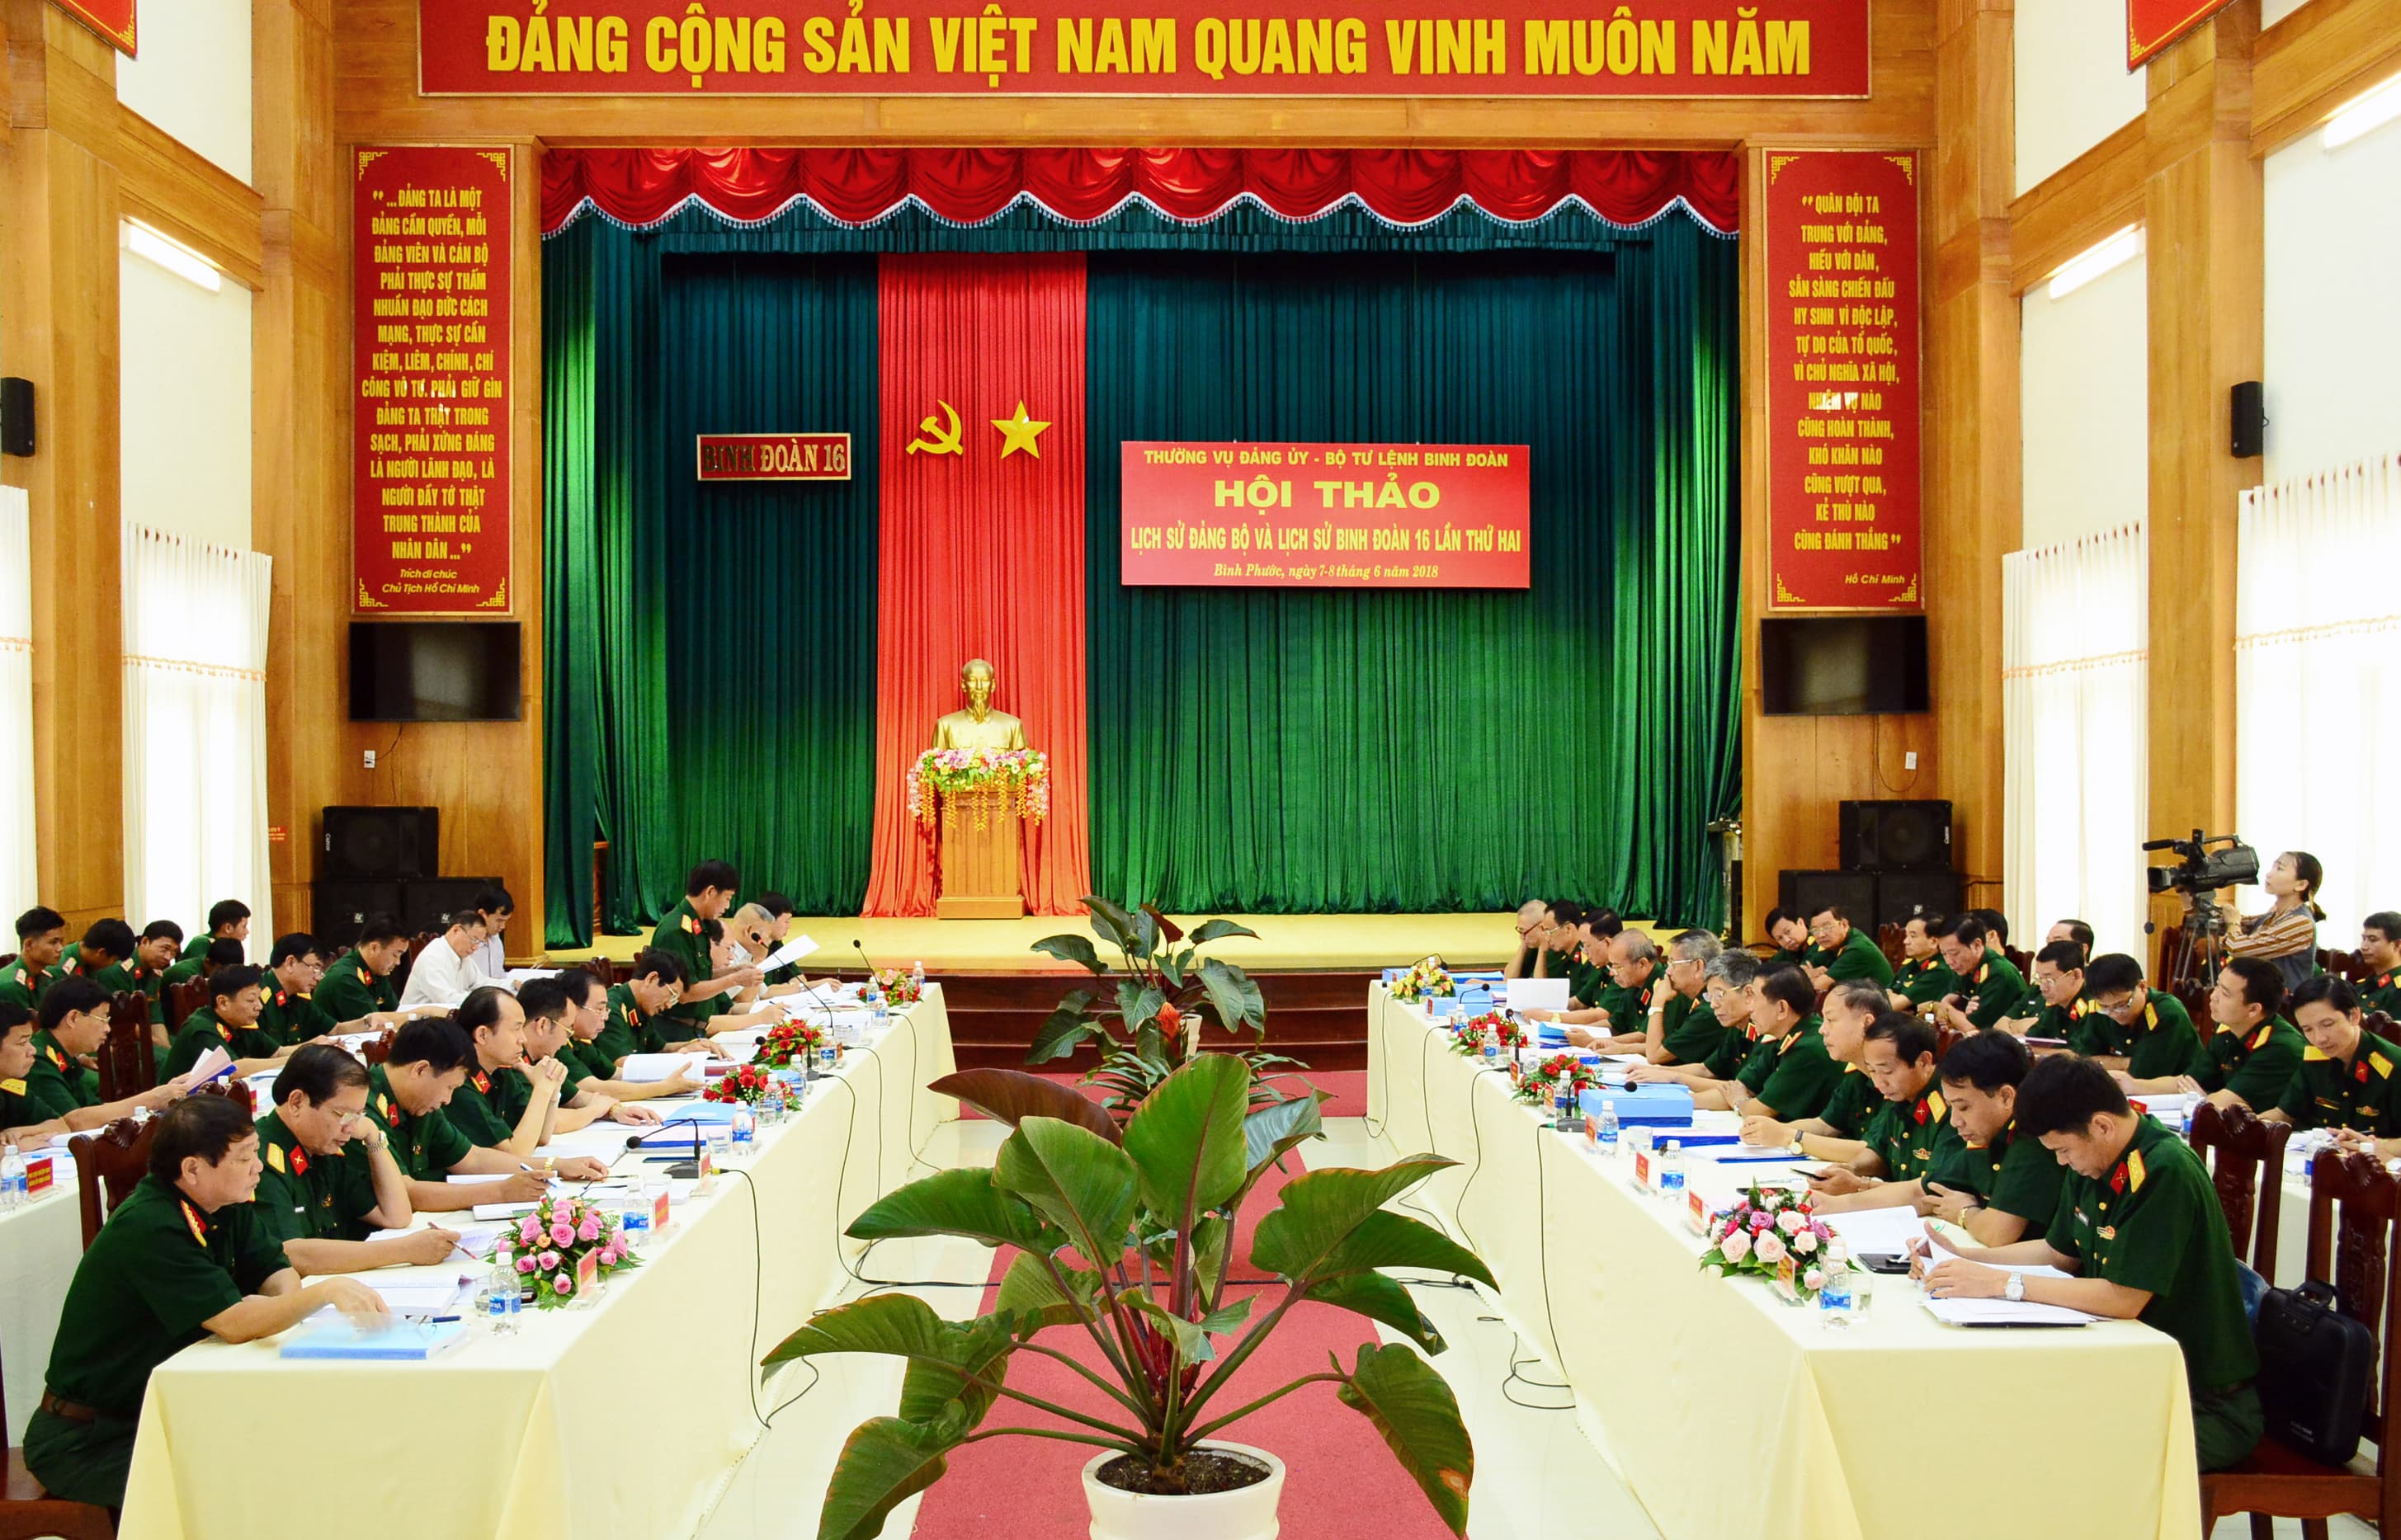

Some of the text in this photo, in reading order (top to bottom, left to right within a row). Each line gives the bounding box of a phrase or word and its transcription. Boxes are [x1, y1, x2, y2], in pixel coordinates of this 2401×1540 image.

[486, 0, 1809, 87] ĐẢNG CỘNG SẢN VIỆT NAM QUANG VINH MUÔN NĂM
[428, 186, 482, 211] TA LÀ MỘT
[1846, 192, 1879, 216] ĐỘI TA
[372, 211, 486, 235] ĐẢNG MỖI
[1801, 219, 1887, 244] TRUNG VỚI ĐẢNG,
[375, 239, 488, 266] ĐẢNG VIÊN VÀ CÁN BỘ
[1809, 248, 1879, 271] HIẾU VỚI DÂN,
[381, 266, 486, 293] PHẢI THỰC SỰ THẤM
[1812, 276, 1839, 298] SÀNG
[1842, 276, 1870, 298] CHIẾN
[1875, 277, 1894, 298] ĐẤU
[413, 299, 433, 319] ĐẠO
[436, 295, 458, 316] ĐỨC
[460, 295, 488, 317] CÁCH
[1795, 304, 1897, 328] HY SINH VÌ ĐỘC LẬP,
[378, 320, 486, 346] MẠNG, THỰC SỰ CẦN
[1796, 334, 1810, 357] TỰ
[1813, 337, 1826, 355] DO
[1828, 330, 1849, 354] CỦA
[1866, 332, 1897, 356] QUỐC,
[373, 349, 403, 373] KIỆM,
[405, 349, 434, 373] LIÊM,
[436, 350, 473, 373] CHÍNH,
[1794, 357, 1900, 384] VÌ CHỦ NGHĨA XÃ HỘI,
[362, 374, 502, 398] CÔNG VÔ TƯ. PHẢI GIỮ GÌN
[1844, 392, 1858, 413] VỤ
[1861, 389, 1881, 410] NÀO
[376, 401, 488, 427] ĐẢNG TA THẬT TRONG
[1798, 416, 1894, 439] CŨNG HOÀN THÀNH,
[370, 427, 494, 454] SẠCH, PHẢI XỨNG ĐÁNG
[704, 438, 845, 473] BINH ĐOÀN 16
[1144, 447, 1507, 469] THƯỜNG VỤ ĐẢNG ỦY BỘ TƯ LỆNH BINH ĐOÀN
[1809, 443, 1882, 464] KHÓ KHĂN NÀO
[370, 457, 495, 482] LÀ NGƯỜI LÃNH ĐẠO, LÀ
[382, 484, 414, 506] NGƯỜI
[442, 485, 455, 506] TỚ
[460, 485, 485, 509] THẬT
[1215, 473, 1440, 516] HỘI THẢO
[1804, 473, 1886, 497] CŨNG VƯỢT QUA,
[384, 509, 480, 533] TRUNG THÀNH CỦA
[1816, 497, 1875, 521] KẺ THÙ NÀO
[392, 538, 422, 558] NHÂN
[1131, 527, 1161, 555] LỊCH
[1167, 520, 1185, 549] SỬ
[1189, 520, 1226, 549] ĐẢNG
[1232, 523, 1249, 556] BỘ
[1254, 523, 1273, 549] VÀ
[1279, 528, 1308, 556] LỊCH
[1314, 521, 1332, 550] SỬ
[1337, 528, 1368, 550] BINH
[1372, 523, 1409, 550] ĐOÀN
[1415, 529, 1430, 551] 16
[1466, 525, 1493, 551] THỨ
[1498, 530, 1520, 551] HAI
[1795, 529, 1852, 550] CŨNG ĐÁNH
[1214, 563, 1438, 580] Bình Phước, ngày 7-8 tháng 6 năm 2018
[1881, 575, 1904, 584] Minh
[382, 582, 402, 593] Chủ
[403, 583, 422, 594] Tịch
[457, 584, 480, 593] Minh
